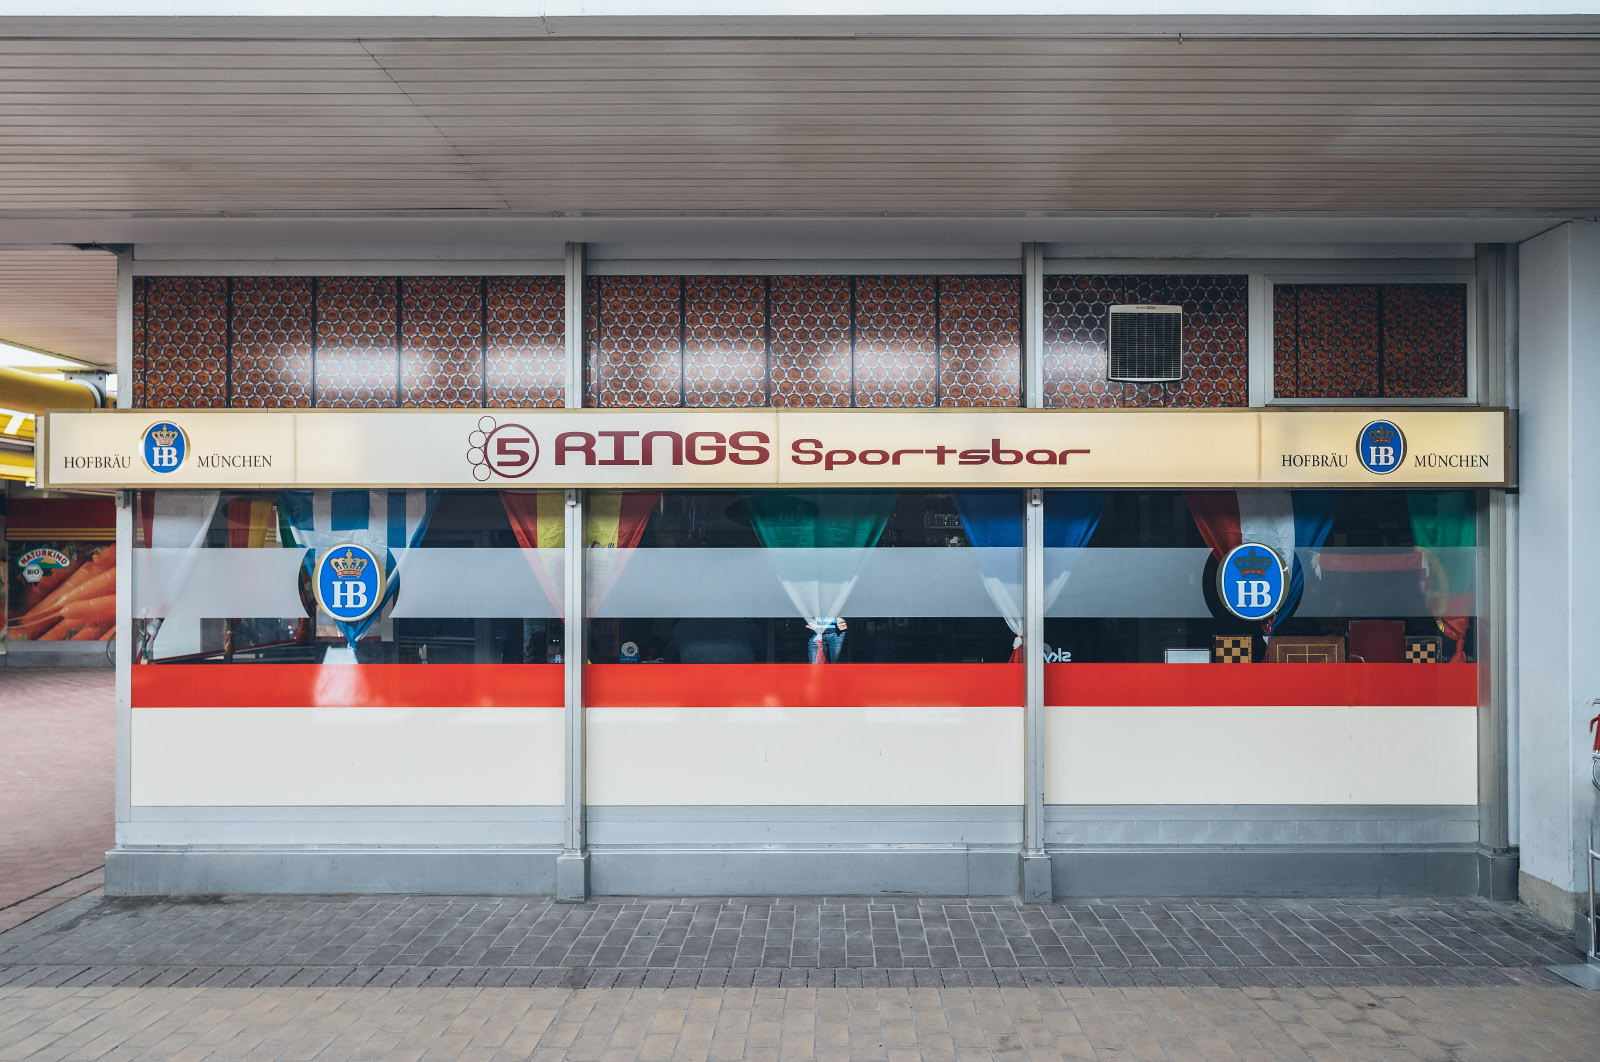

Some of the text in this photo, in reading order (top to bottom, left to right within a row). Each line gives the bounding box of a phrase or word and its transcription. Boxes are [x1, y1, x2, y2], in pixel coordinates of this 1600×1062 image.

[64, 446, 273, 469] HOFBRÄU HB MÜNCHEN
[496, 430, 1091, 471] 5 RINGS Sportsbar
[1281, 446, 1490, 468] HOFBRÄU HB MÜNCHEN
[20, 548, 68, 566] NATURKIND
[331, 580, 368, 609] HB
[1235, 580, 1272, 608] HB
